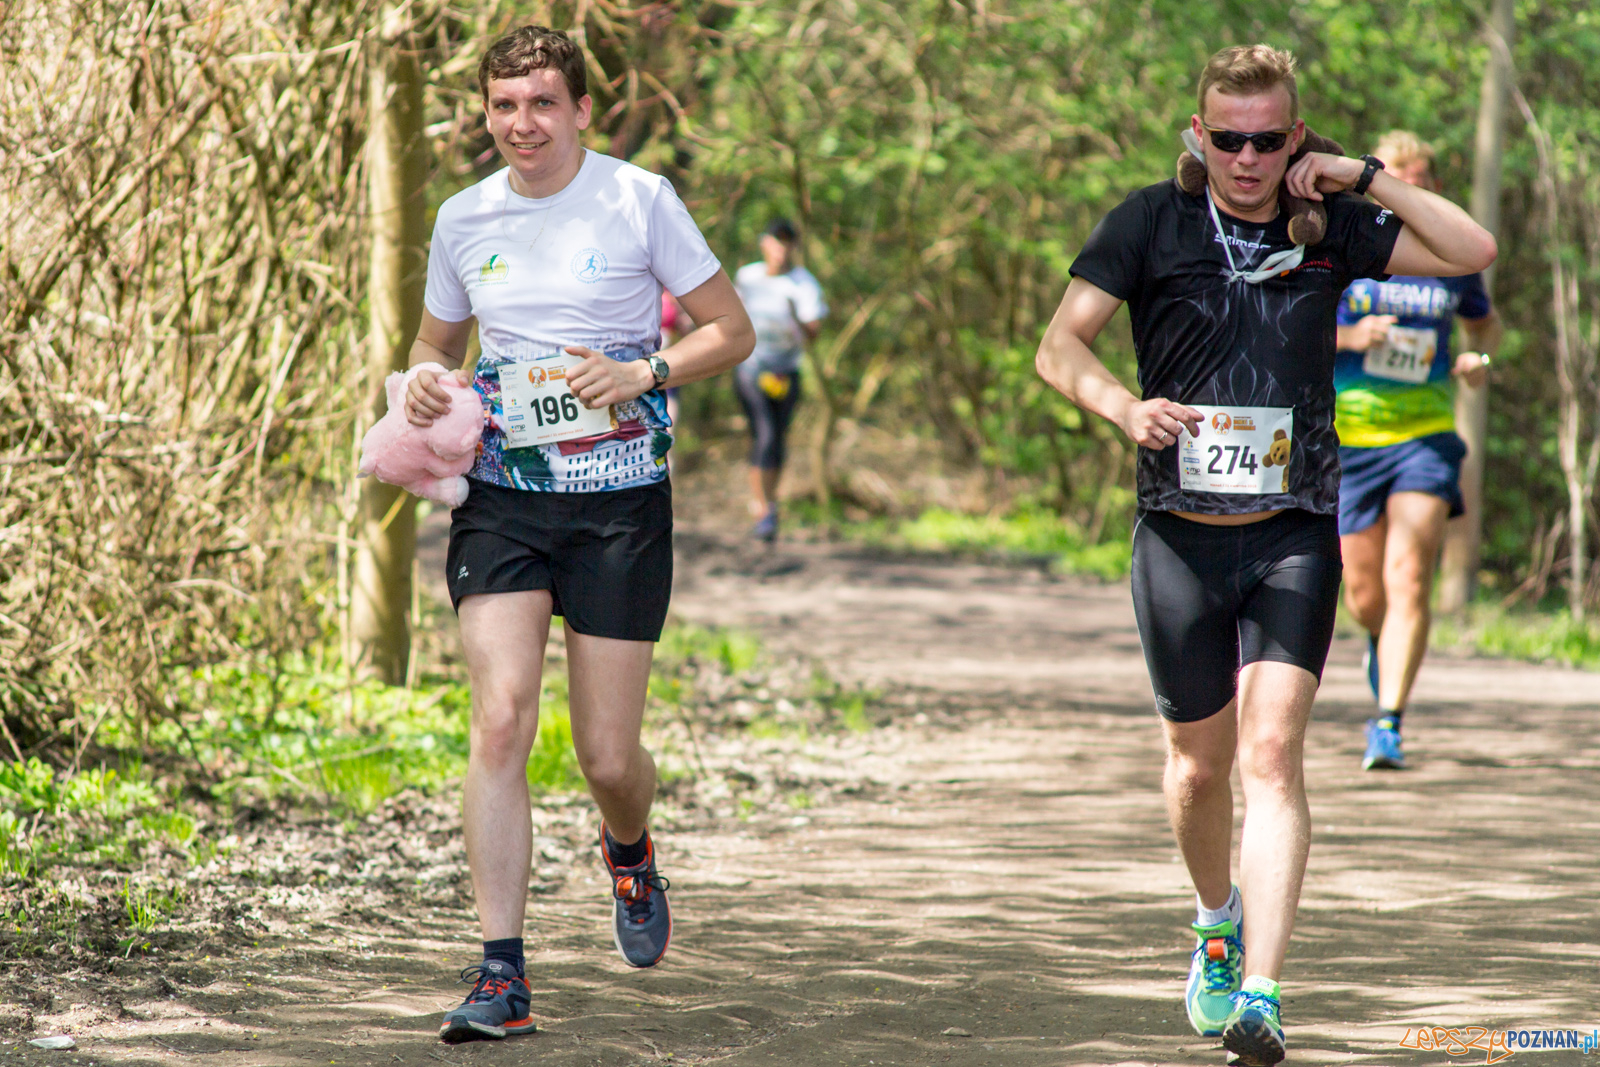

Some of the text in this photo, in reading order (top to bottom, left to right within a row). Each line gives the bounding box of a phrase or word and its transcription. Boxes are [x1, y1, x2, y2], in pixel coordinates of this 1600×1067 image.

[1377, 281, 1431, 307] TEAM
[1387, 349, 1416, 370] 271
[530, 393, 579, 427] 196
[1207, 445, 1258, 475] 274
